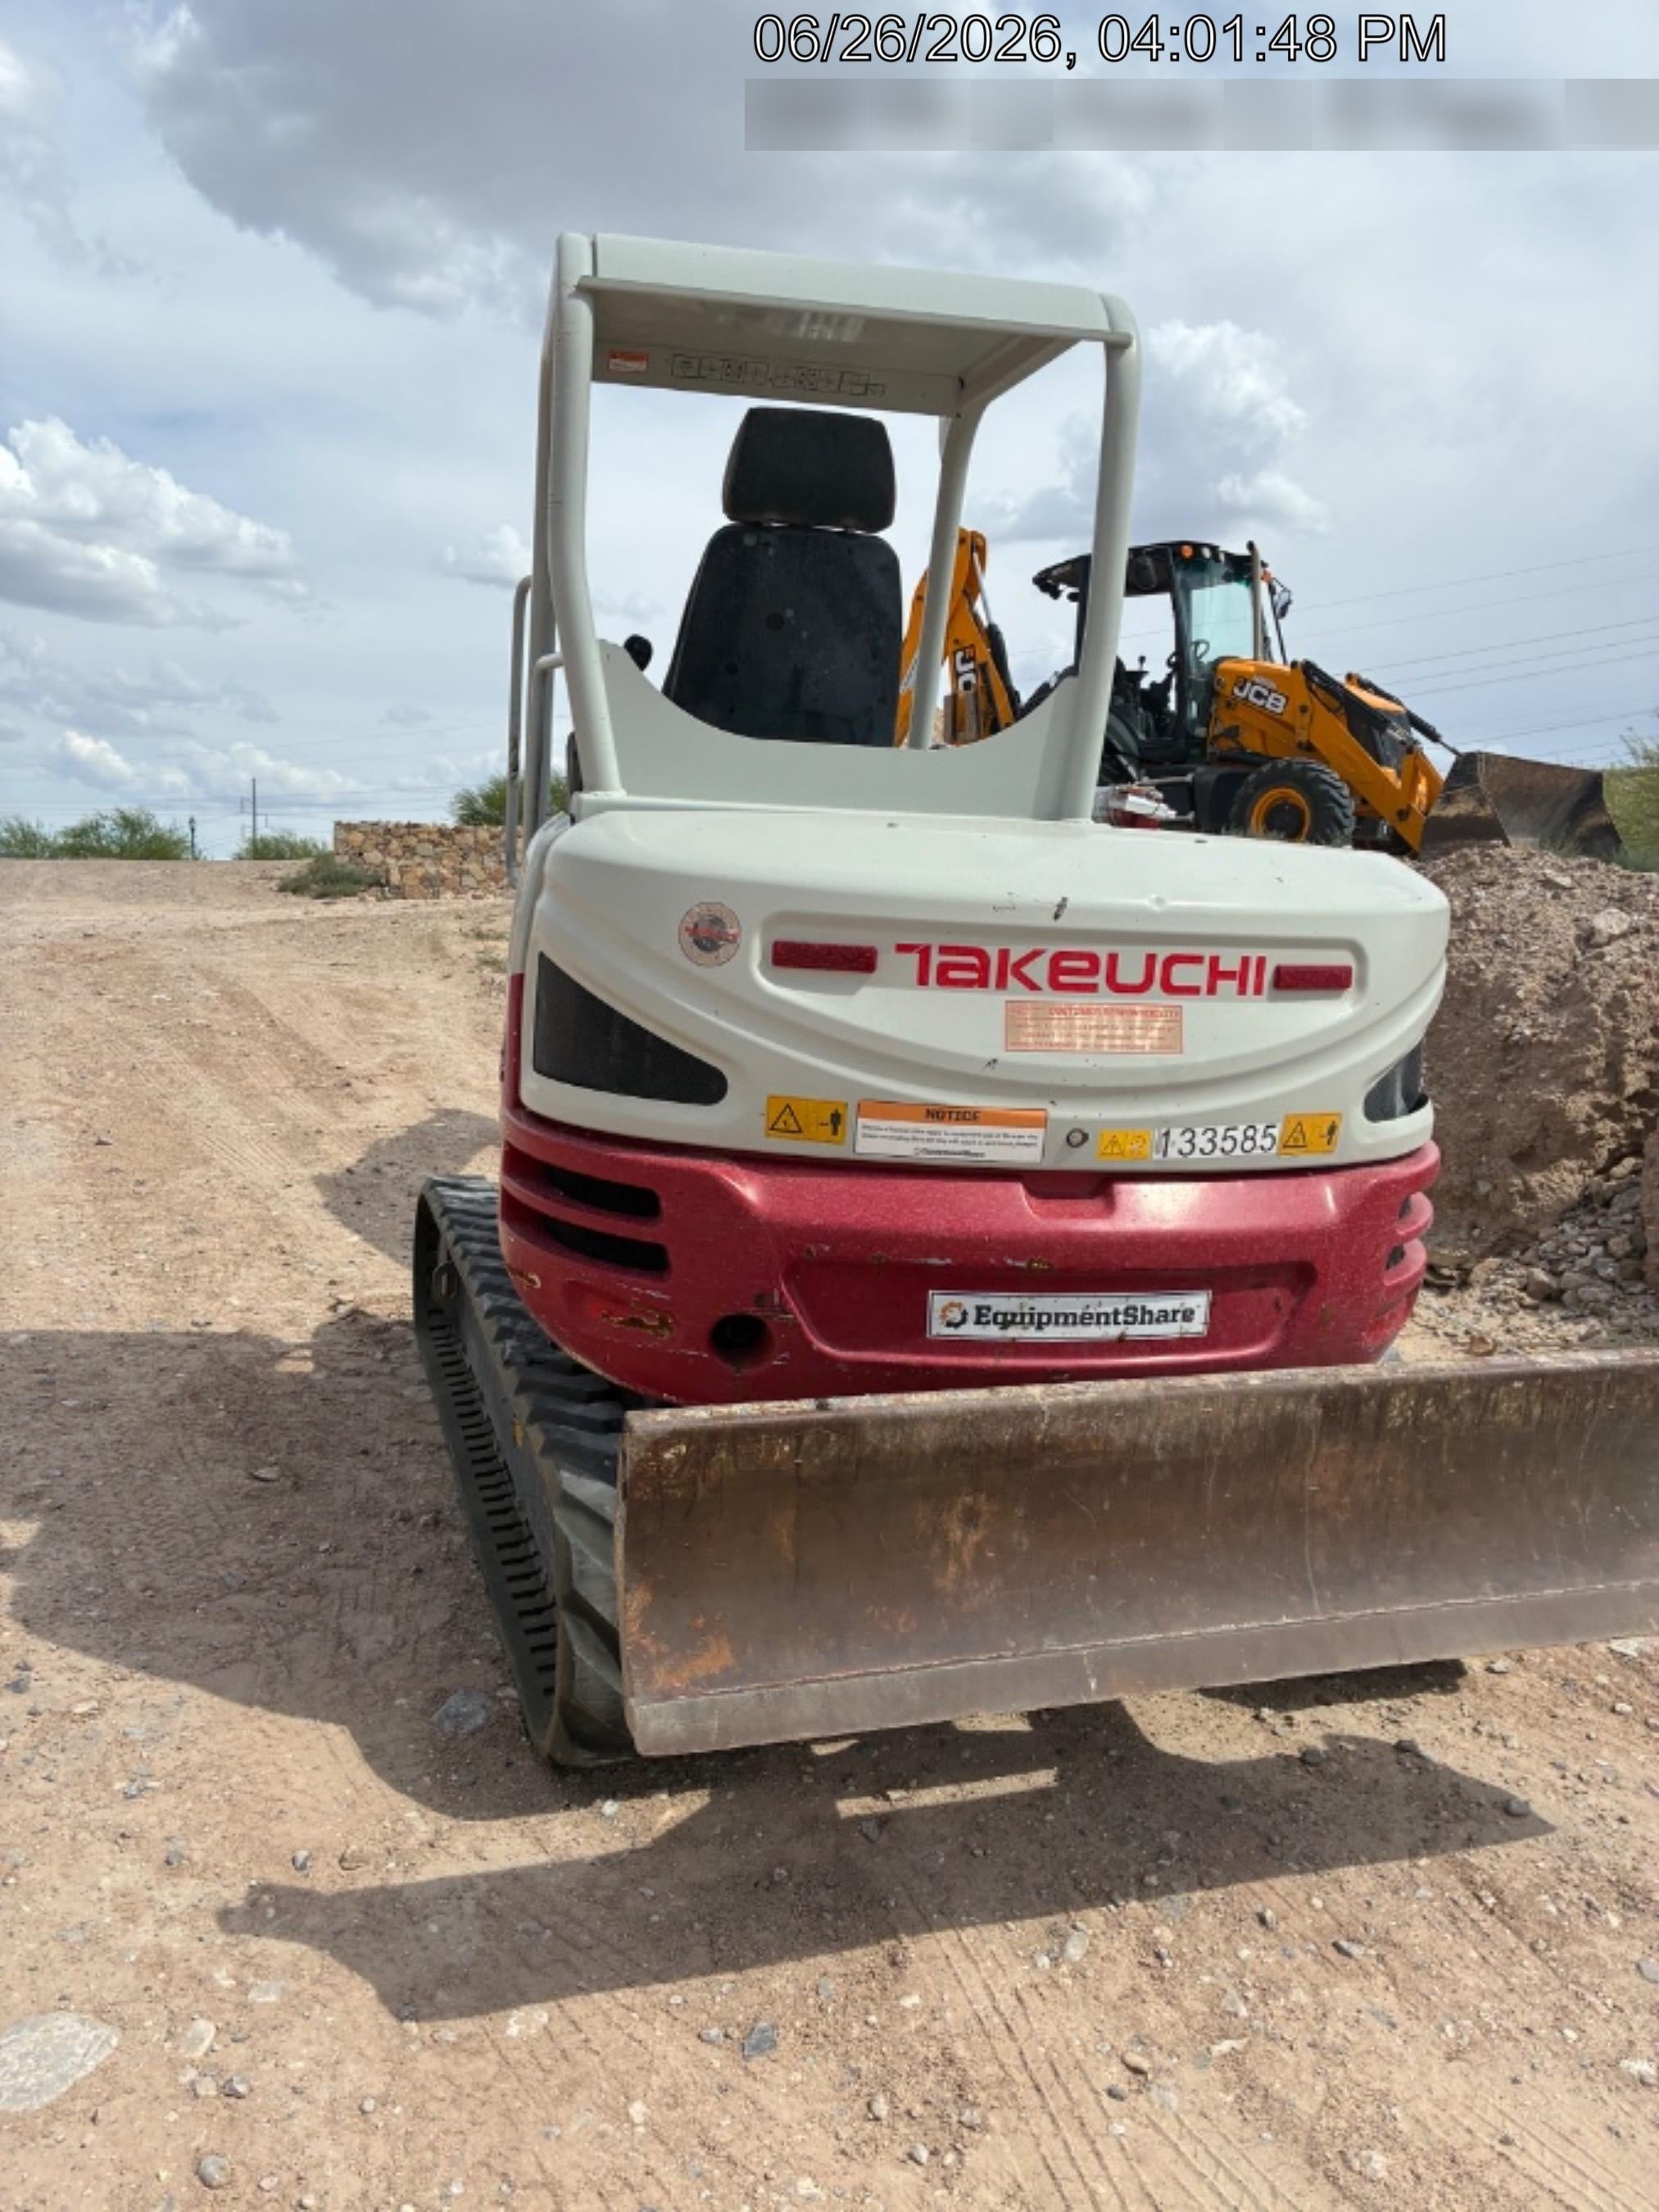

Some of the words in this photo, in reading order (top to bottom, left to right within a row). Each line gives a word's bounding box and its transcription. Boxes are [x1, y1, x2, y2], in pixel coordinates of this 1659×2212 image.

[955, 648, 976, 692] JC
[1233, 679, 1287, 714] JCB
[924, 1108, 981, 1122] NOTICE
[1162, 1124, 1277, 1158] 133585
[972, 1304, 1196, 1330] EquipmentShare
